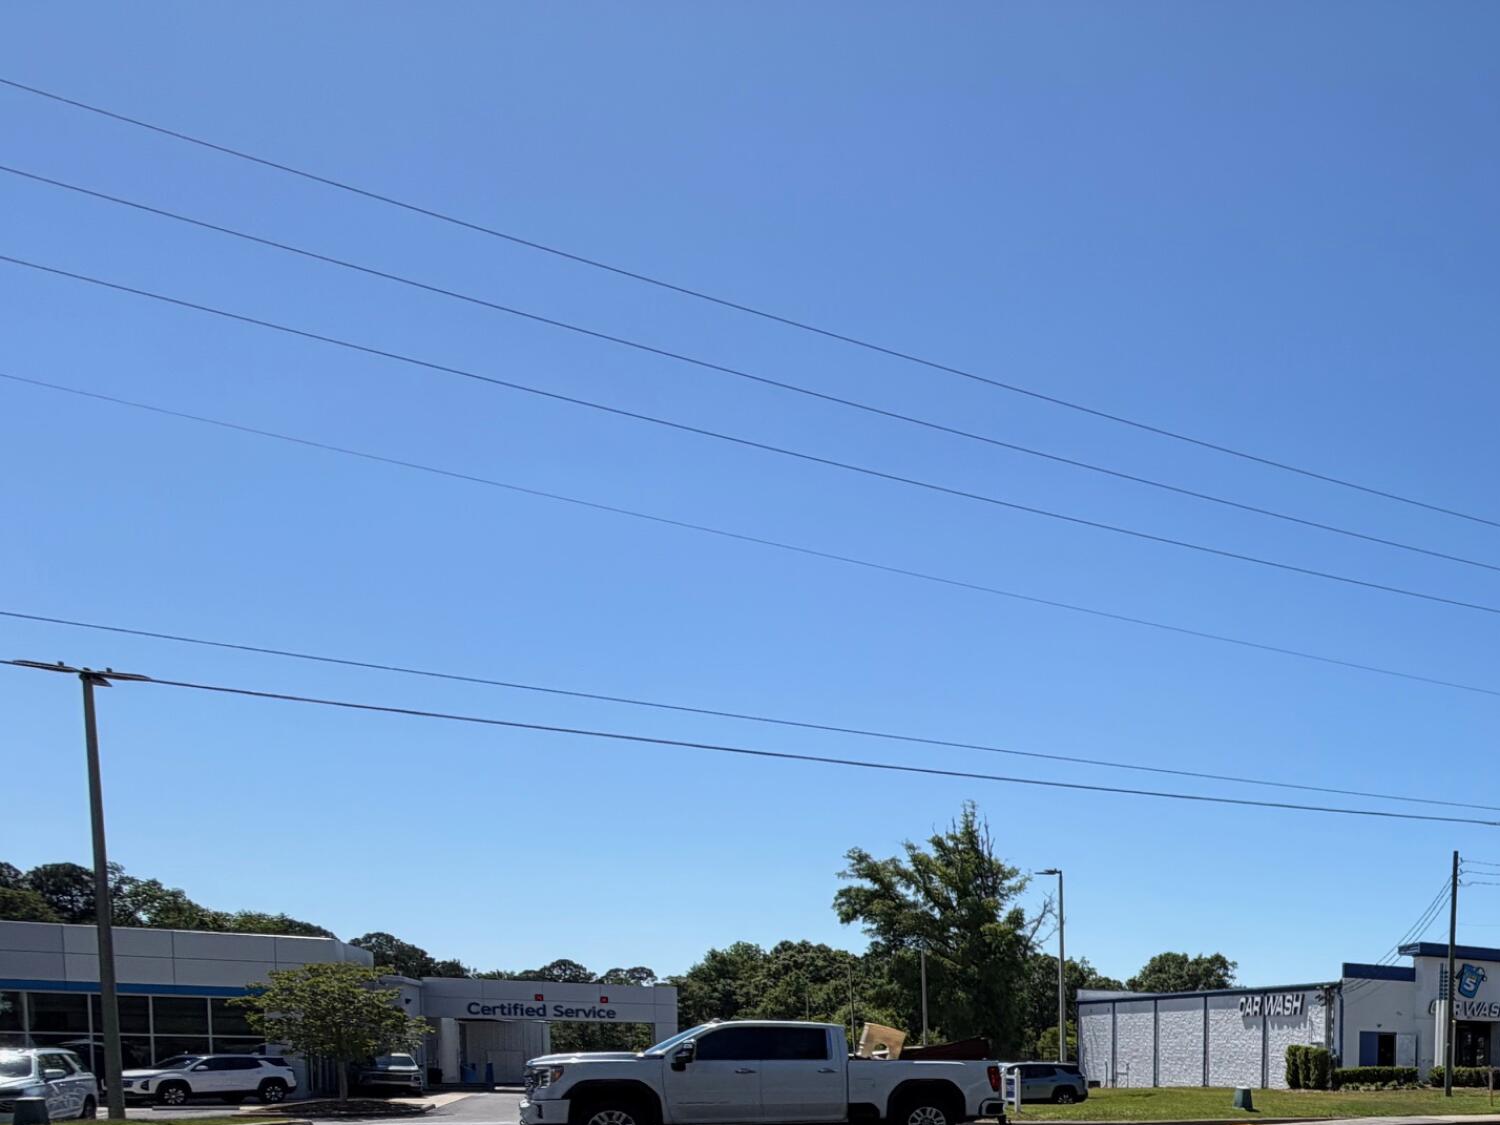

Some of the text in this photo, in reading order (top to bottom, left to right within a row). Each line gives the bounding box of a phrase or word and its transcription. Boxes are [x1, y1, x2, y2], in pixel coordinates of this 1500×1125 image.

[467, 1002, 616, 1019] Certified Service
[1240, 993, 1305, 1017] CAR WASH
[1428, 999, 1462, 1017] CR
